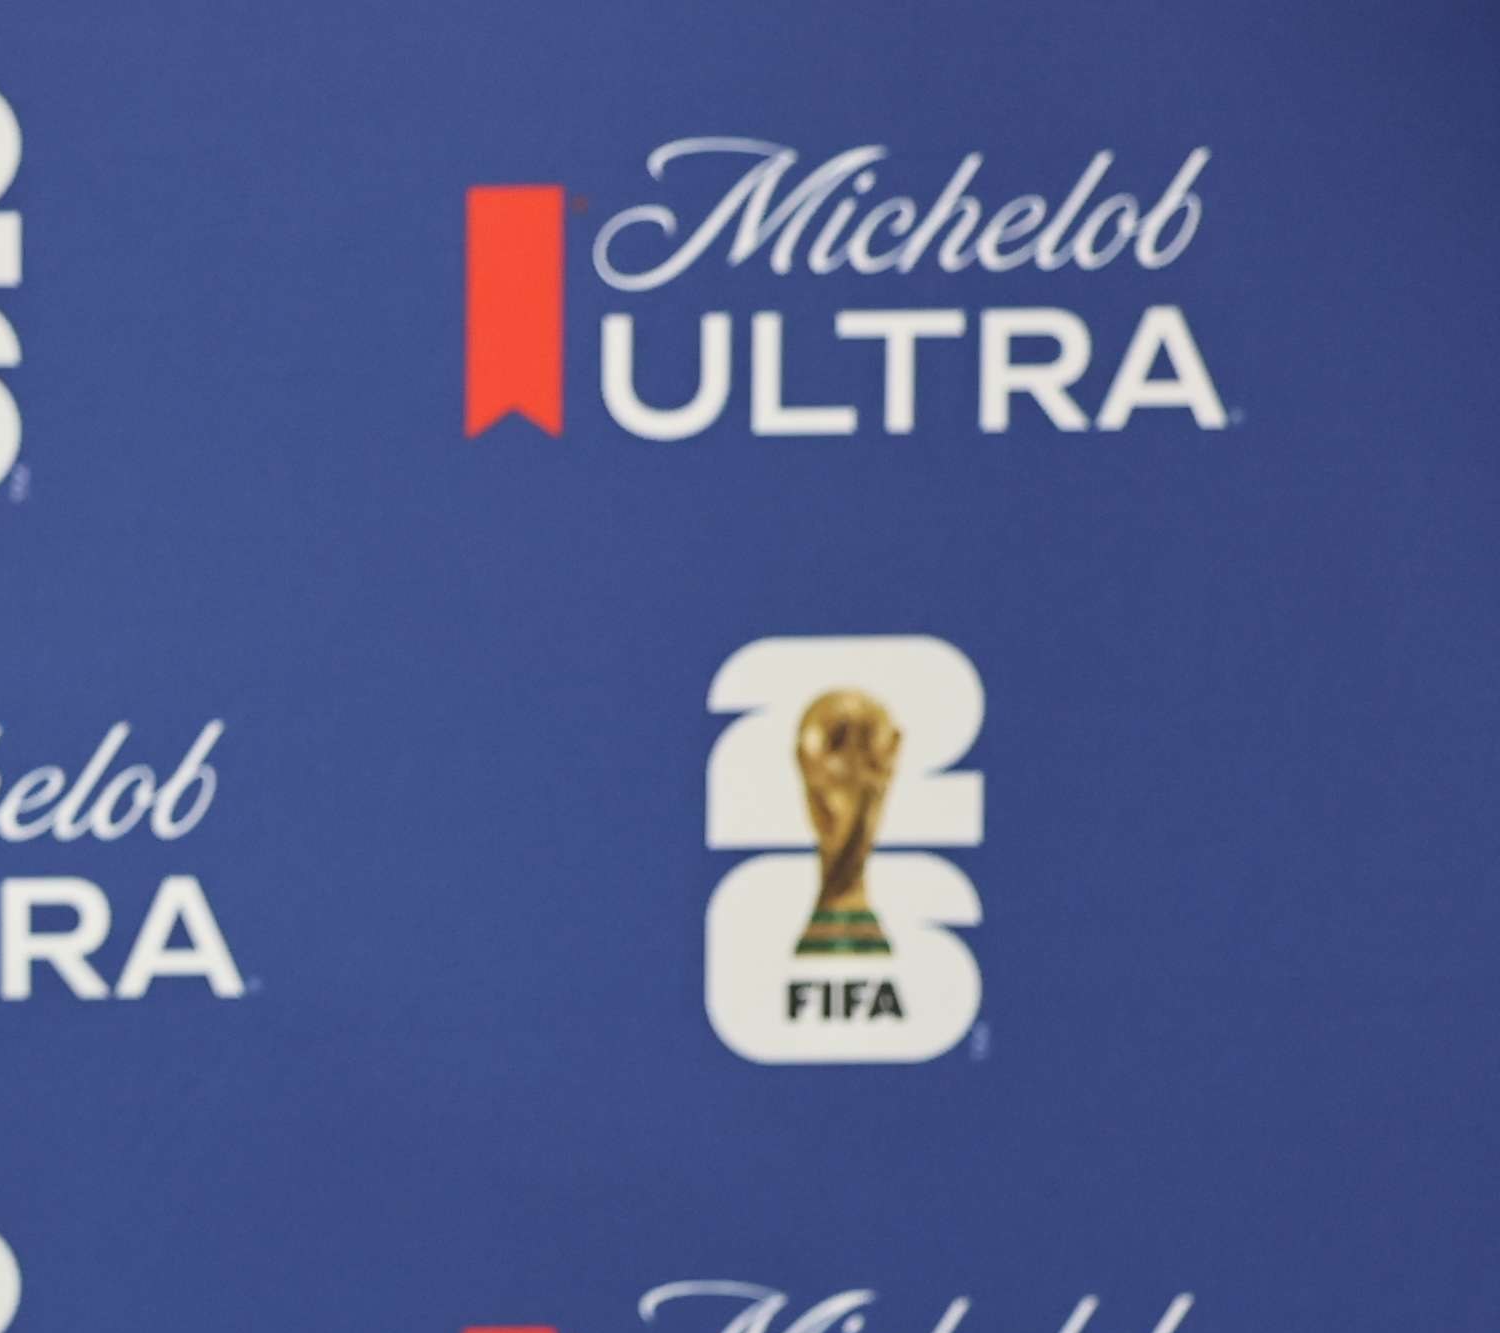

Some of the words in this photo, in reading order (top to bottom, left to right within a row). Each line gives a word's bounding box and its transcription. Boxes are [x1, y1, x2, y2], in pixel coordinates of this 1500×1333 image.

[591, 136, 1210, 293] Michelob
[600, 304, 1228, 442] ULTRA
[785, 978, 906, 1022] FIFA
